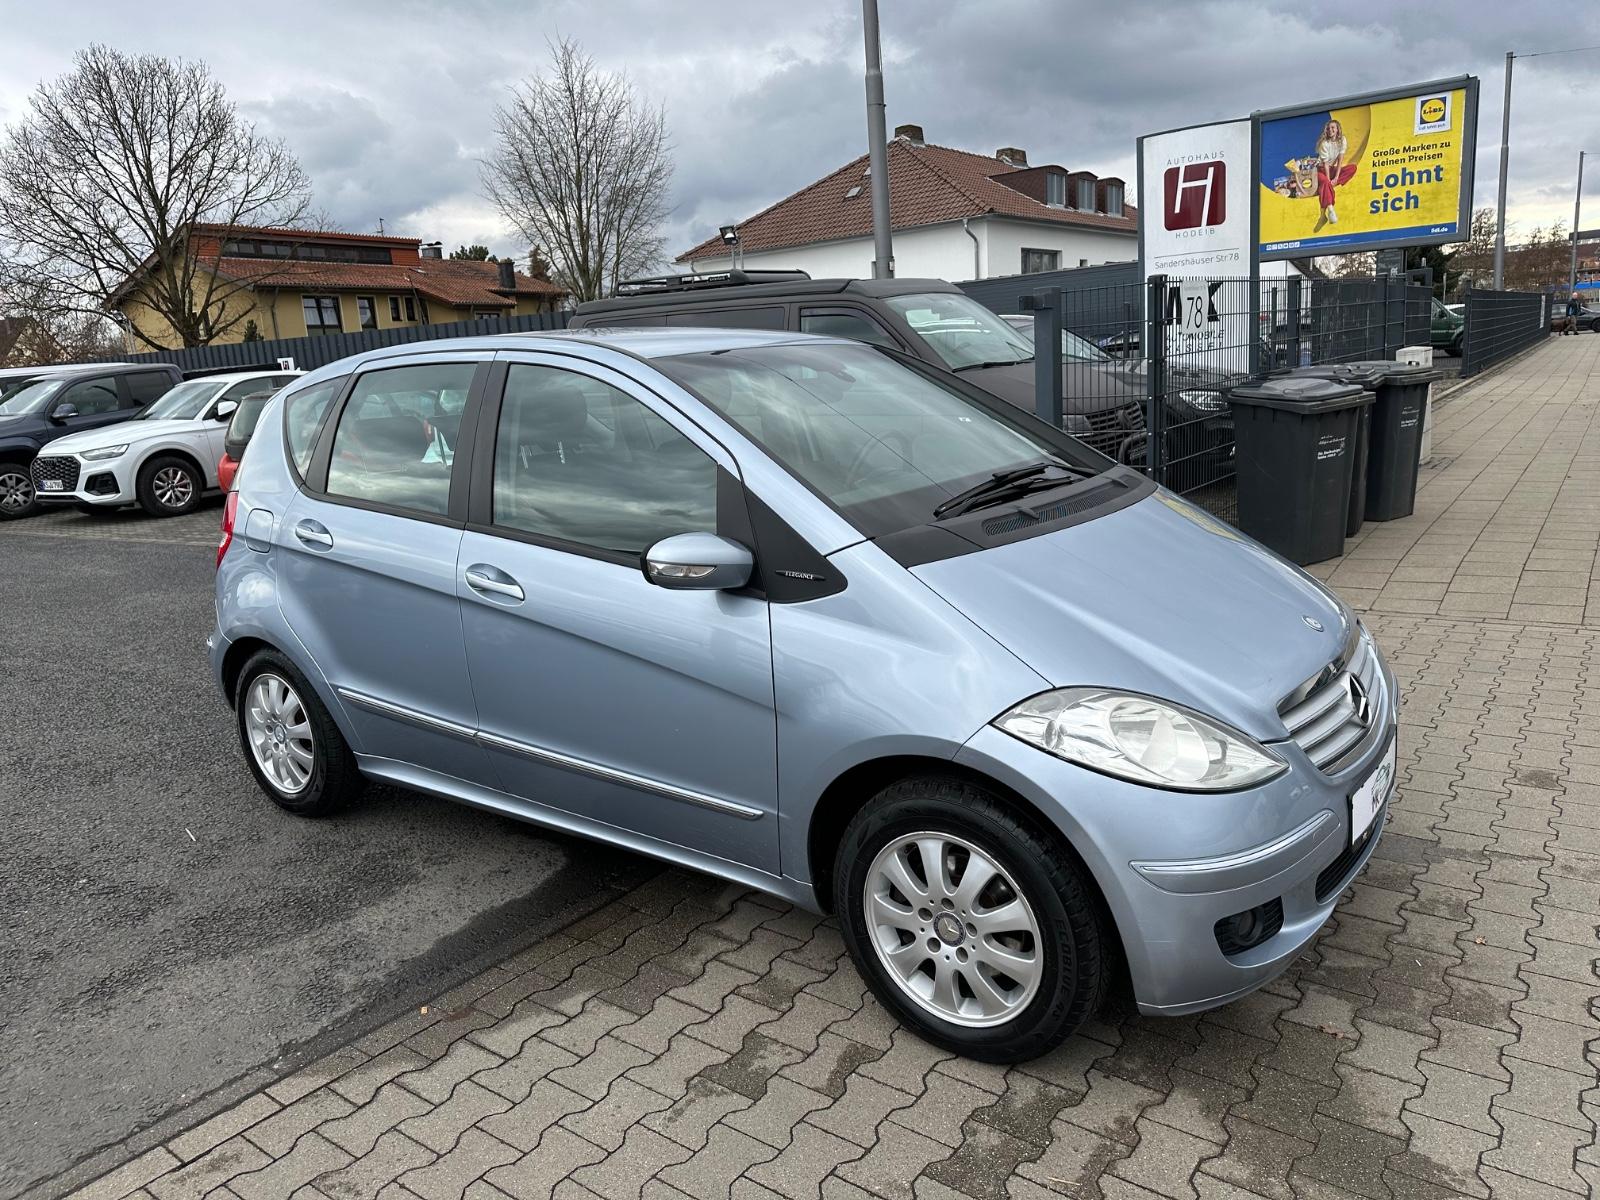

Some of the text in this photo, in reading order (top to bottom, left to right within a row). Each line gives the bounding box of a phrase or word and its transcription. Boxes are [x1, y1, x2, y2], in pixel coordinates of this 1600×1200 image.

[1372, 141, 1451, 158] Große Marken zu
[1166, 150, 1226, 166] AUTOHAUS
[1372, 152, 1443, 168] kleinen Preisen
[1371, 164, 1444, 190] Lohnt
[1369, 190, 1420, 214] sich
[1175, 228, 1216, 239] HODEIB
[1154, 256, 1214, 270] Sandershäuser
[1186, 295, 1203, 329] 78
